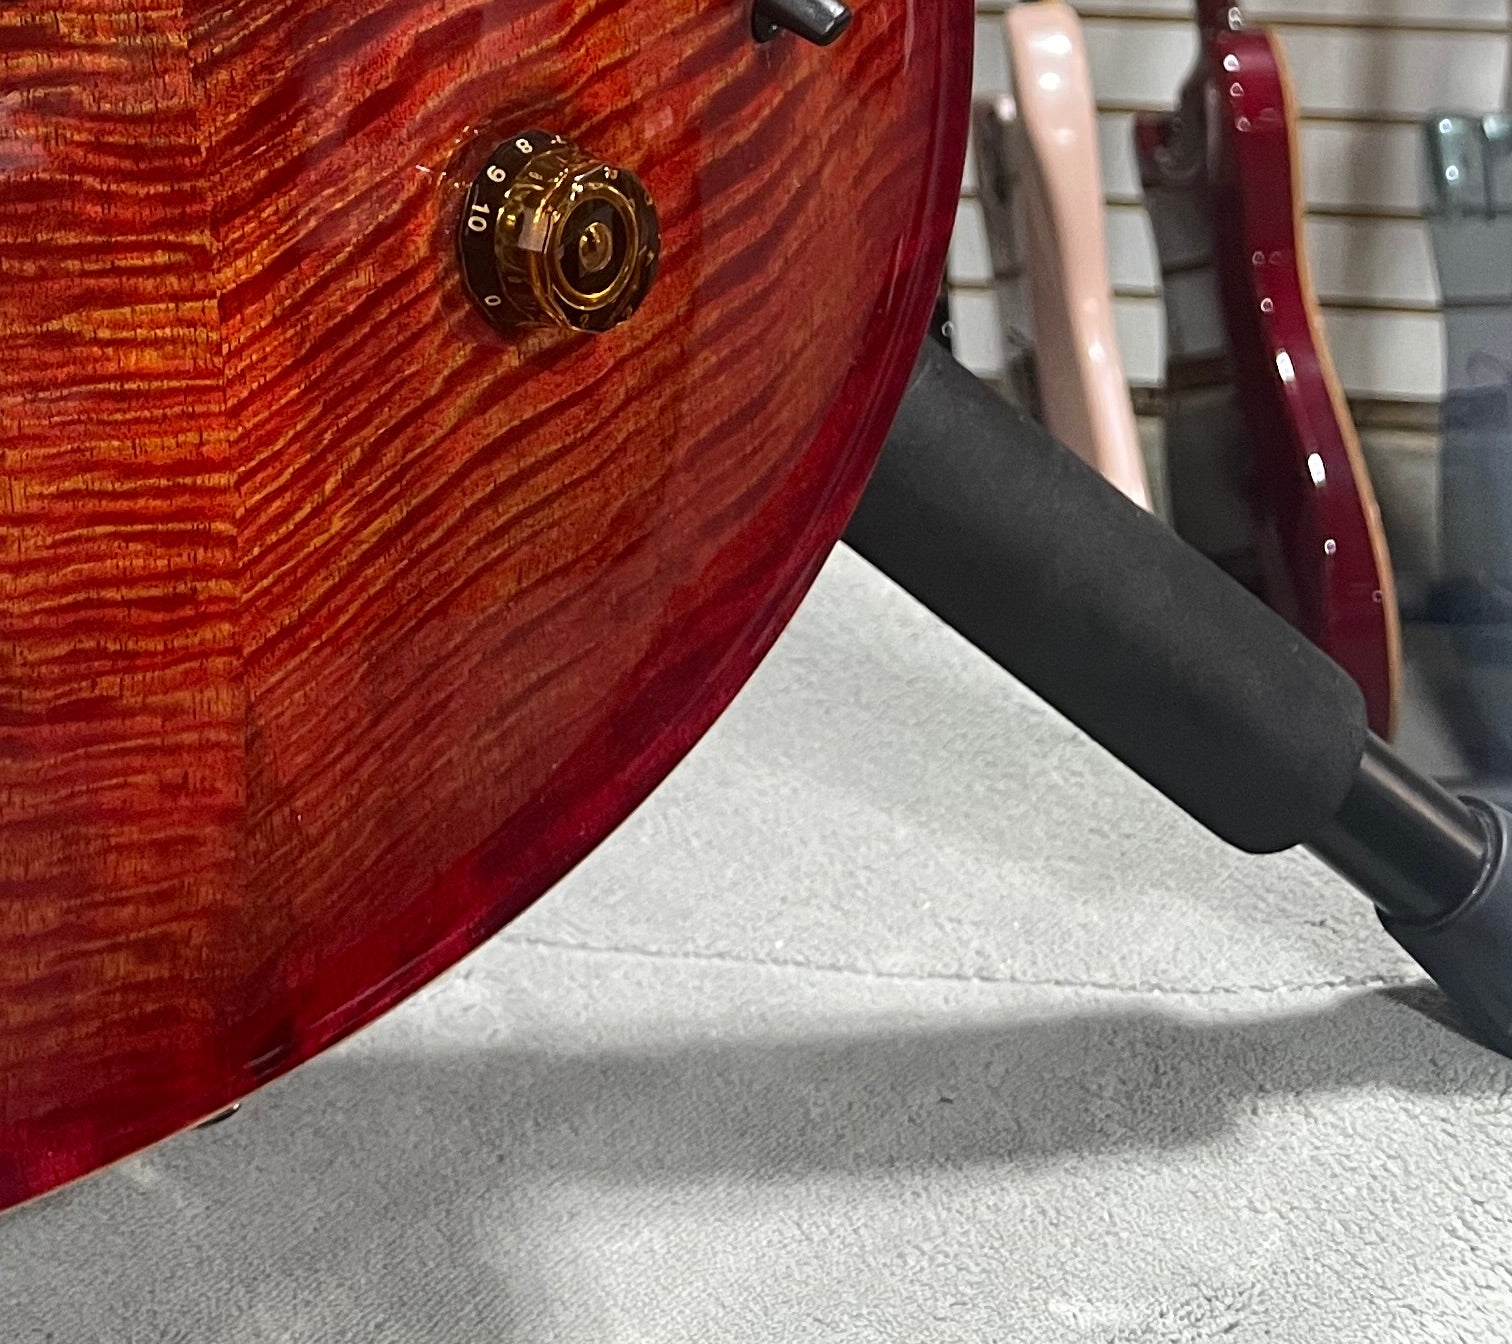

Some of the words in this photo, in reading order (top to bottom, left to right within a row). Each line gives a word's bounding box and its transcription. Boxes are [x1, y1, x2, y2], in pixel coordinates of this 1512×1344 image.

[515, 138, 533, 154] 8
[486, 165, 506, 183] 9
[467, 203, 490, 232] 10
